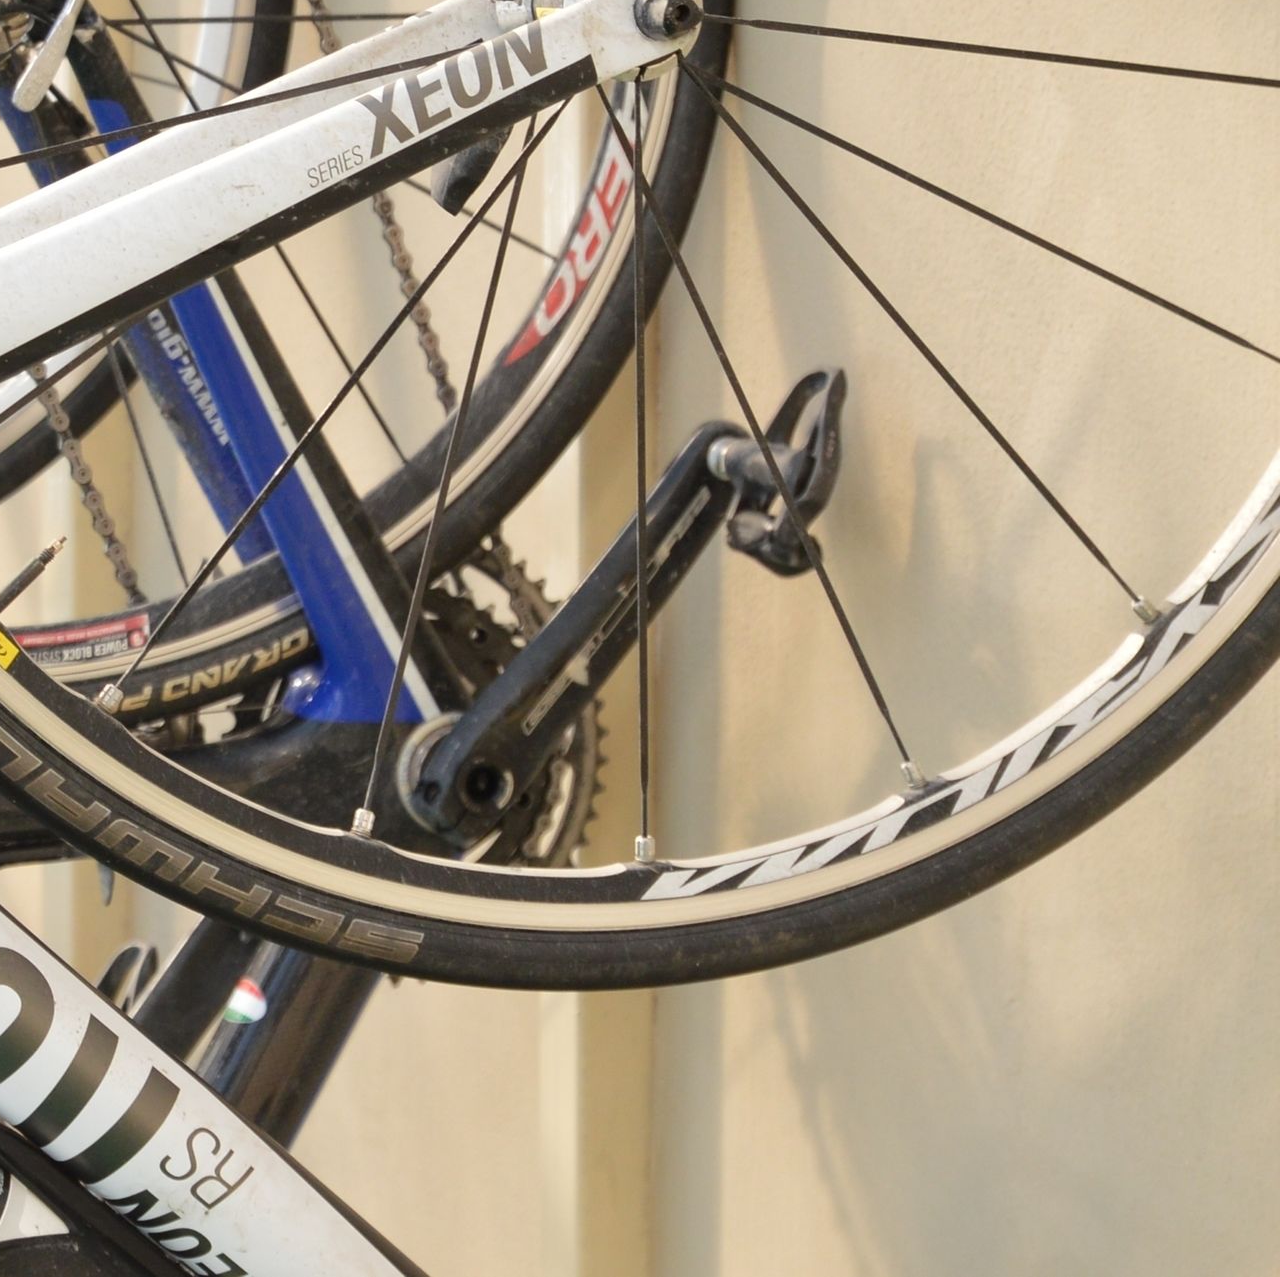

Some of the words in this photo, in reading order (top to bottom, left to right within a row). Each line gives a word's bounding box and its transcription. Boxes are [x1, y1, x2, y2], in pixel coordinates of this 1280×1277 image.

[355, 26, 549, 158] XEON
[306, 143, 365, 189] SERIES
[61, 644, 94, 662] BLOCK
[93, 636, 129, 657] POWER
[158, 625, 312, 704] GRAND
[158, 1126, 256, 1210] RS
